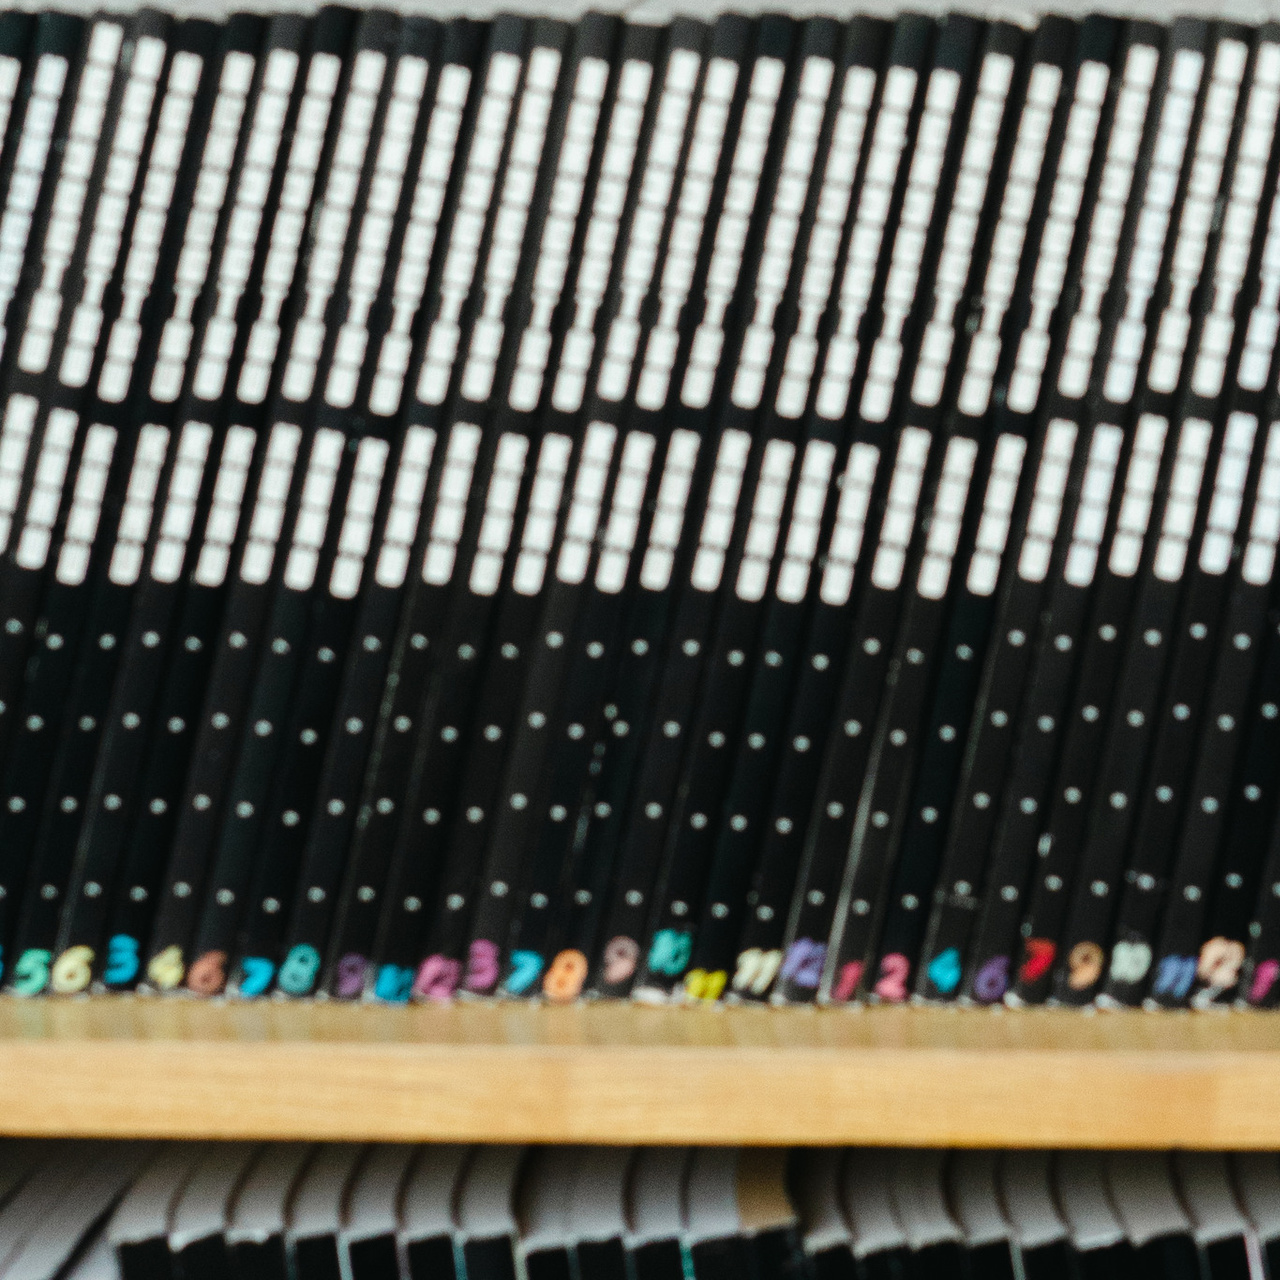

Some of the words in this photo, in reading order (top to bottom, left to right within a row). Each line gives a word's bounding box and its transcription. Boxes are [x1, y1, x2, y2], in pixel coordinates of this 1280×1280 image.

[52, 945, 95, 994] 6
[239, 956, 275, 999] 7
[278, 943, 321, 994] 8
[505, 949, 545, 995] 7
[543, 948, 588, 1002] 8
